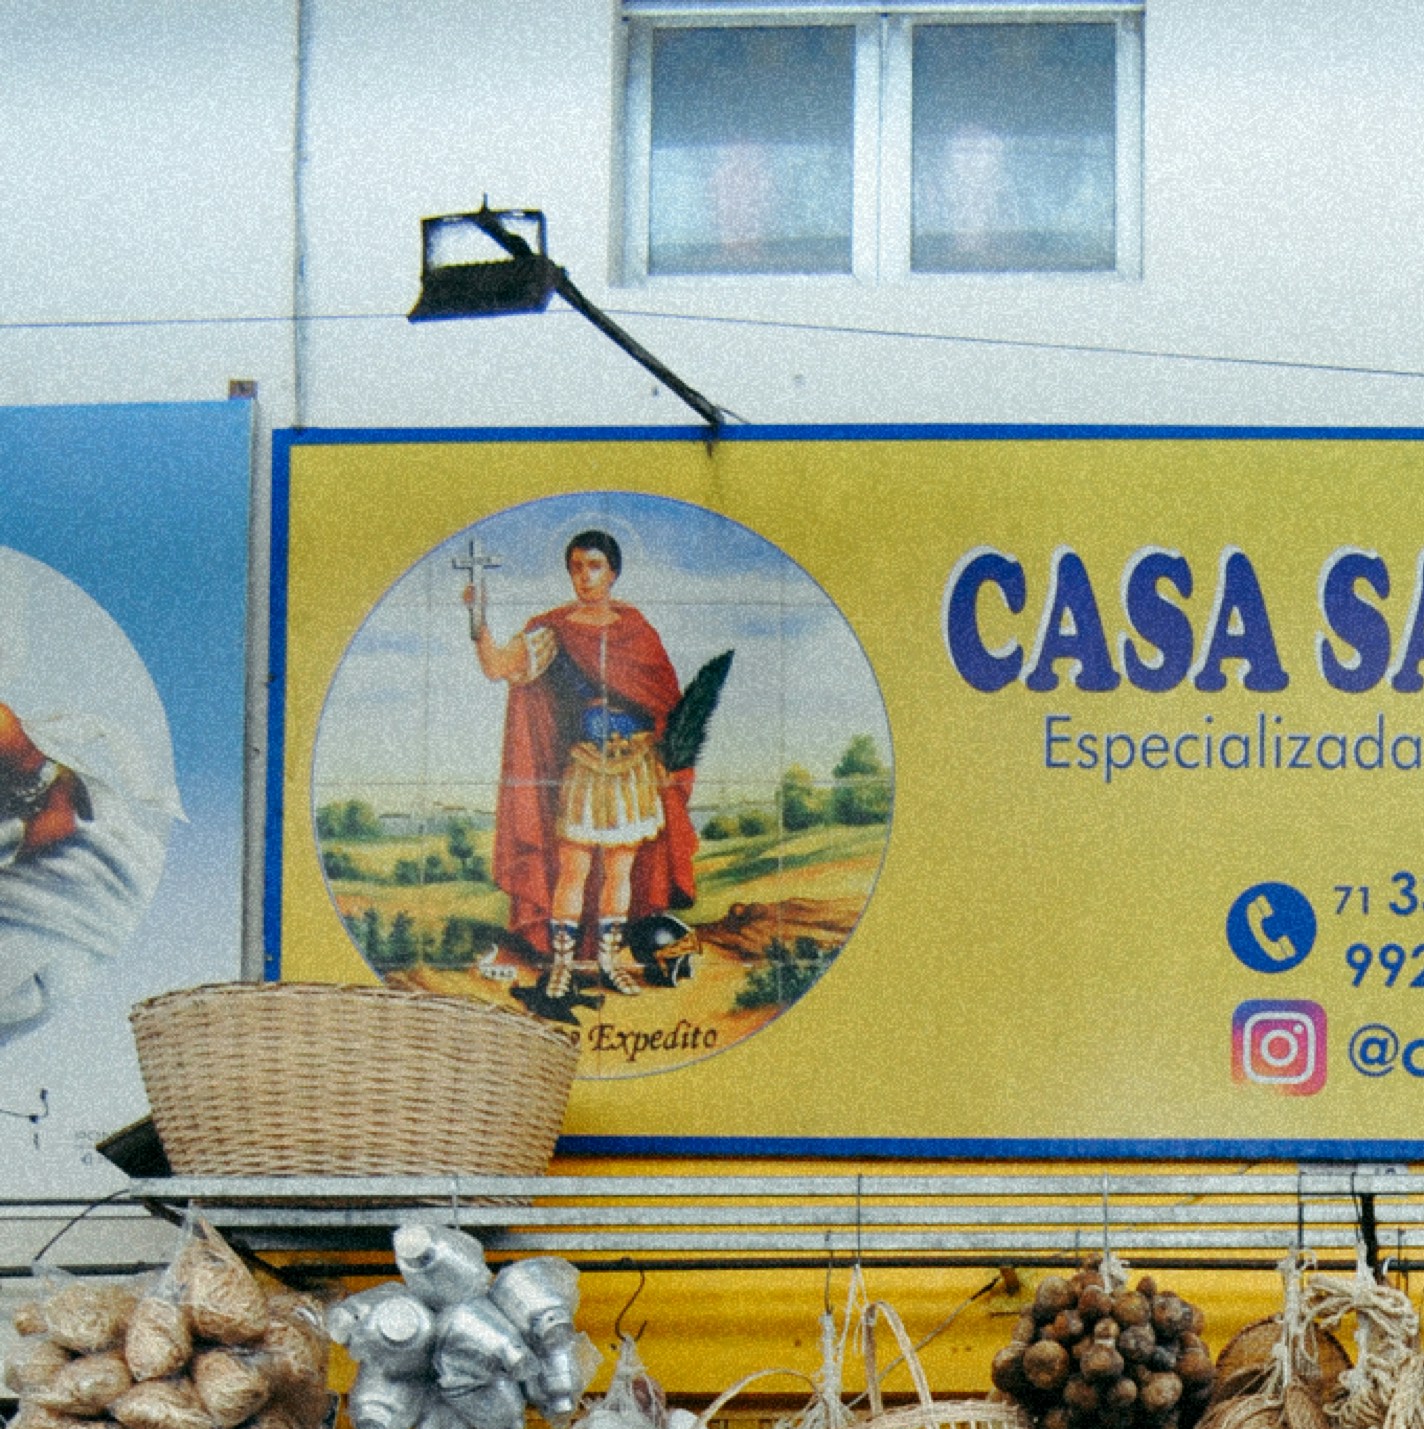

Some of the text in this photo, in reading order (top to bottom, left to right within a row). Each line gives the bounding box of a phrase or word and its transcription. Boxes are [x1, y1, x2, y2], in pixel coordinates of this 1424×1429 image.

[943, 546, 1289, 692] CASA
[1044, 713, 1422, 782] Especializada
[1335, 886, 1371, 915] 71
[588, 1019, 718, 1062] Expedito
